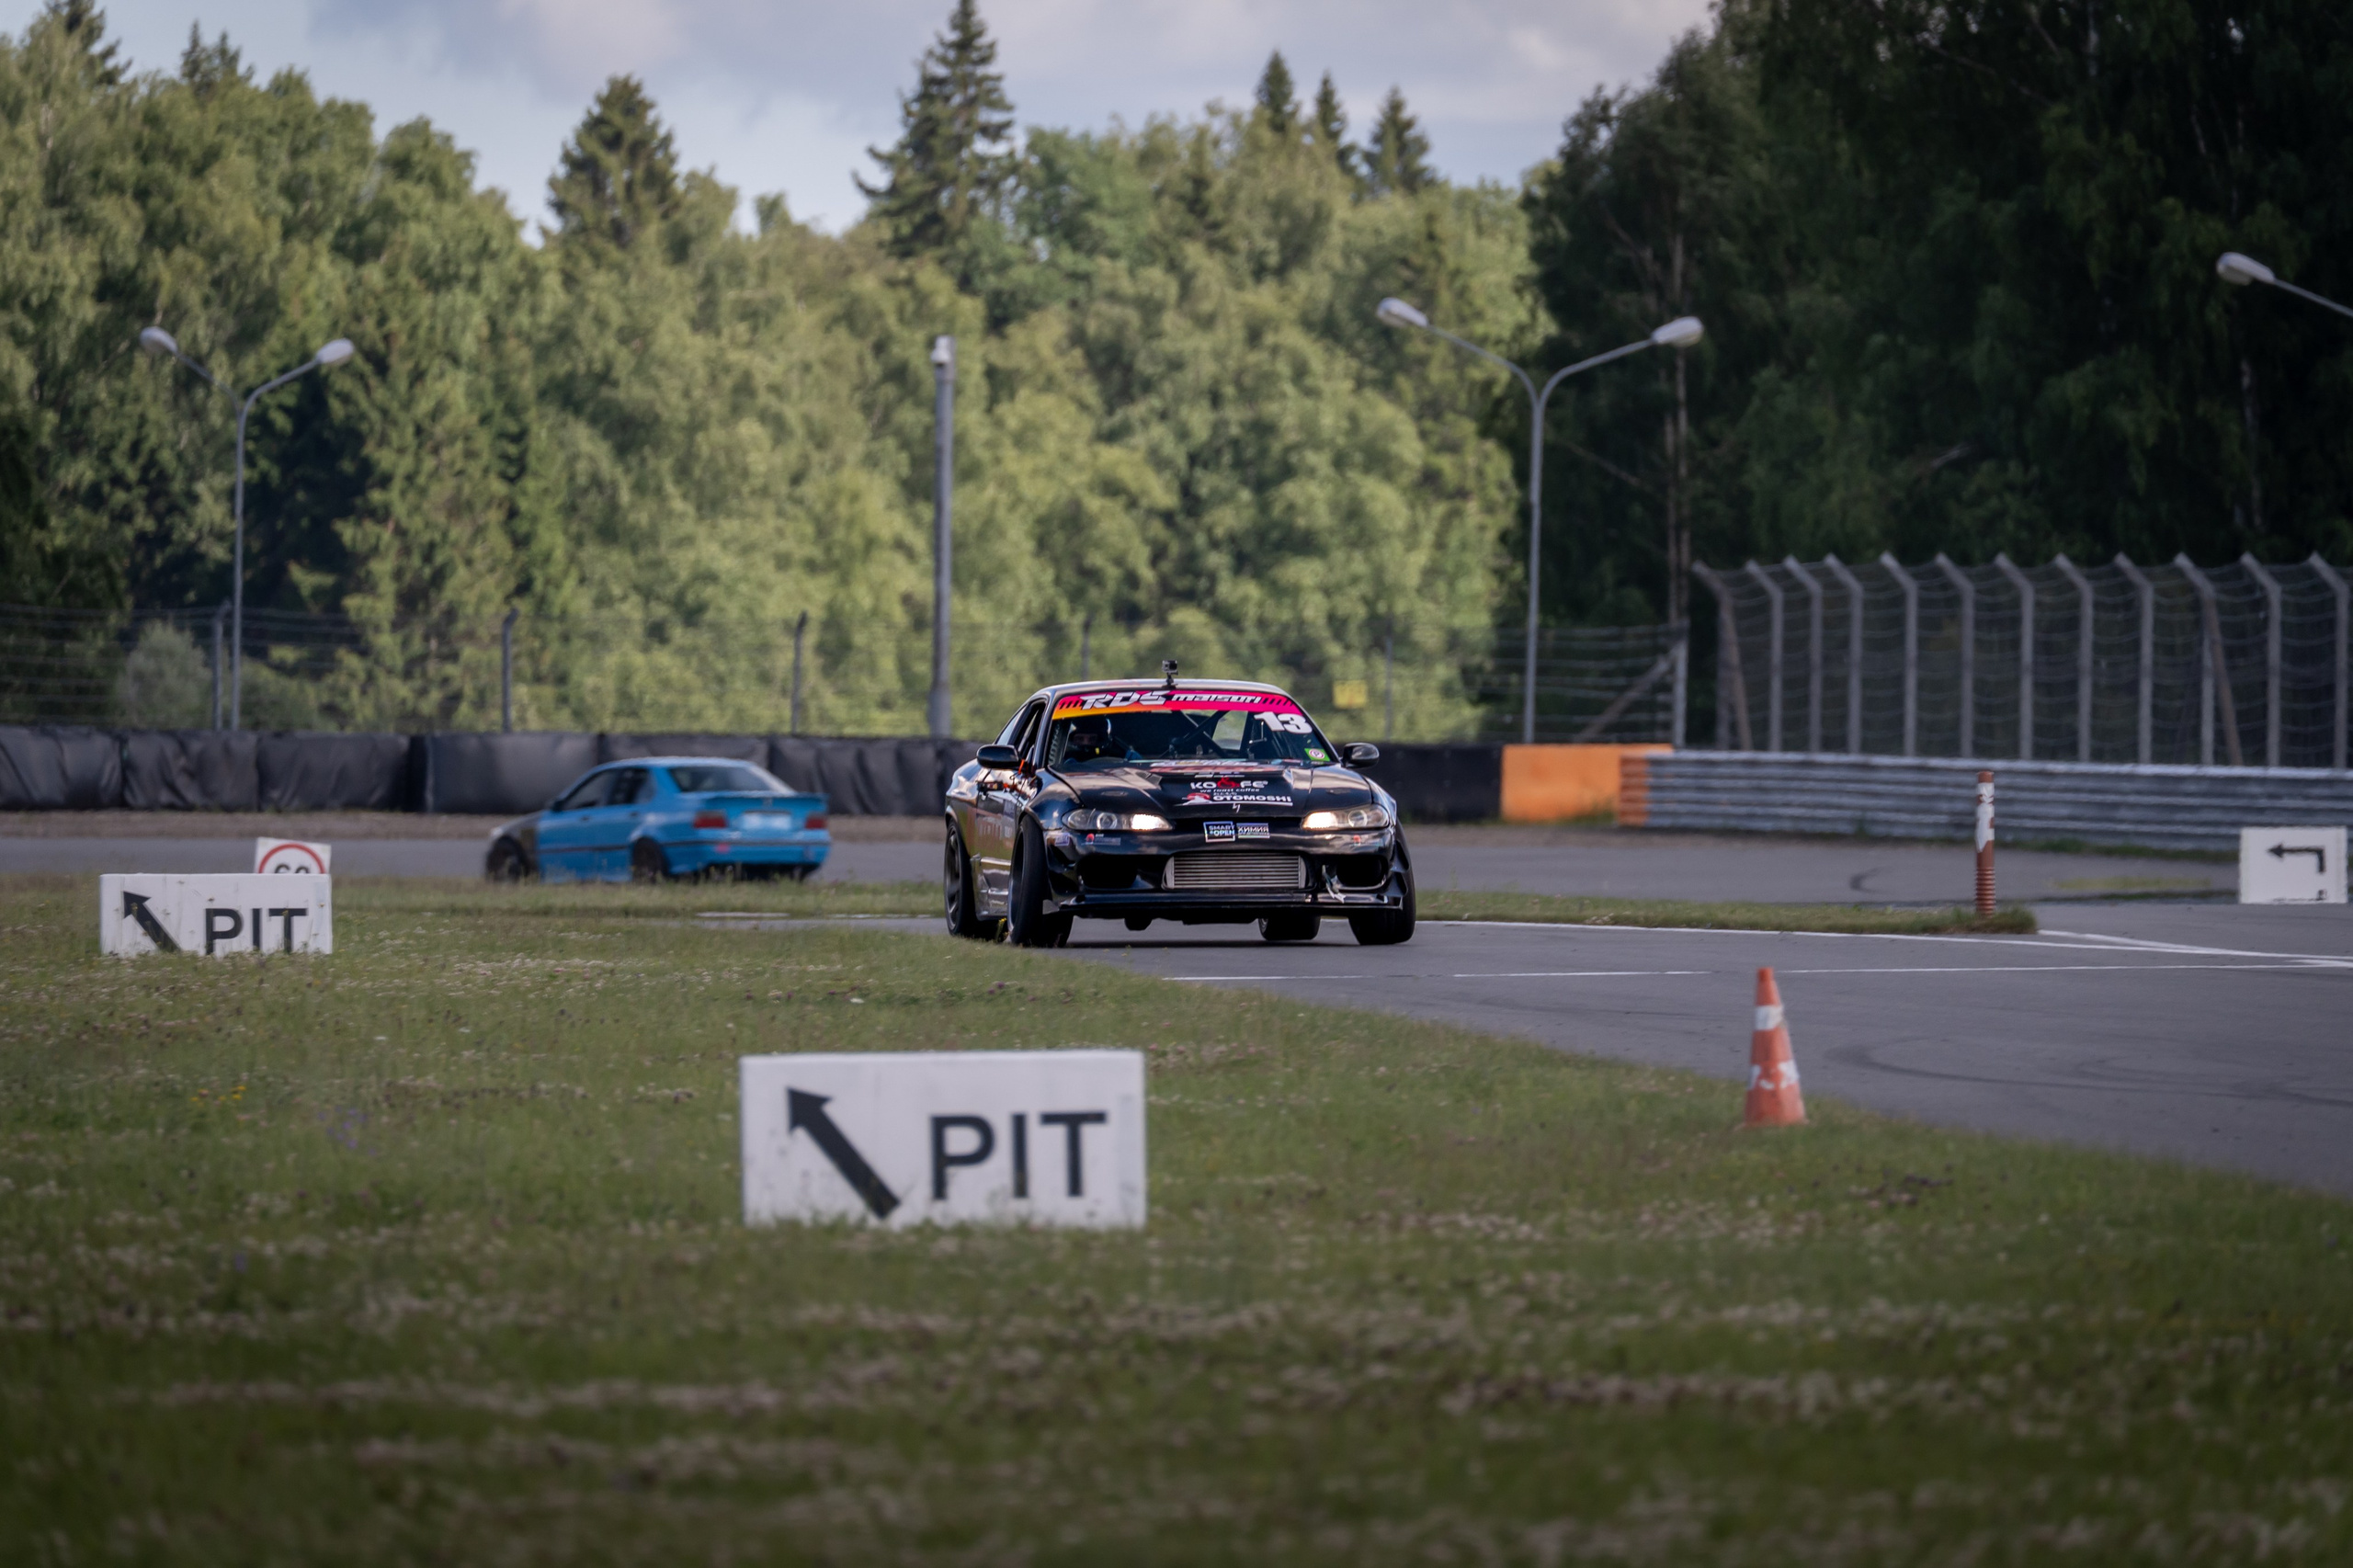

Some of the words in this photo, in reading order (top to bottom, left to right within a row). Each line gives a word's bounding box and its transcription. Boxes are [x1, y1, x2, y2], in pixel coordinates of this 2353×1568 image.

[1079, 690, 1171, 710] RDS
[1254, 711, 1313, 734] 13
[205, 907, 309, 955] PIT
[930, 1110, 1108, 1201] PIT
